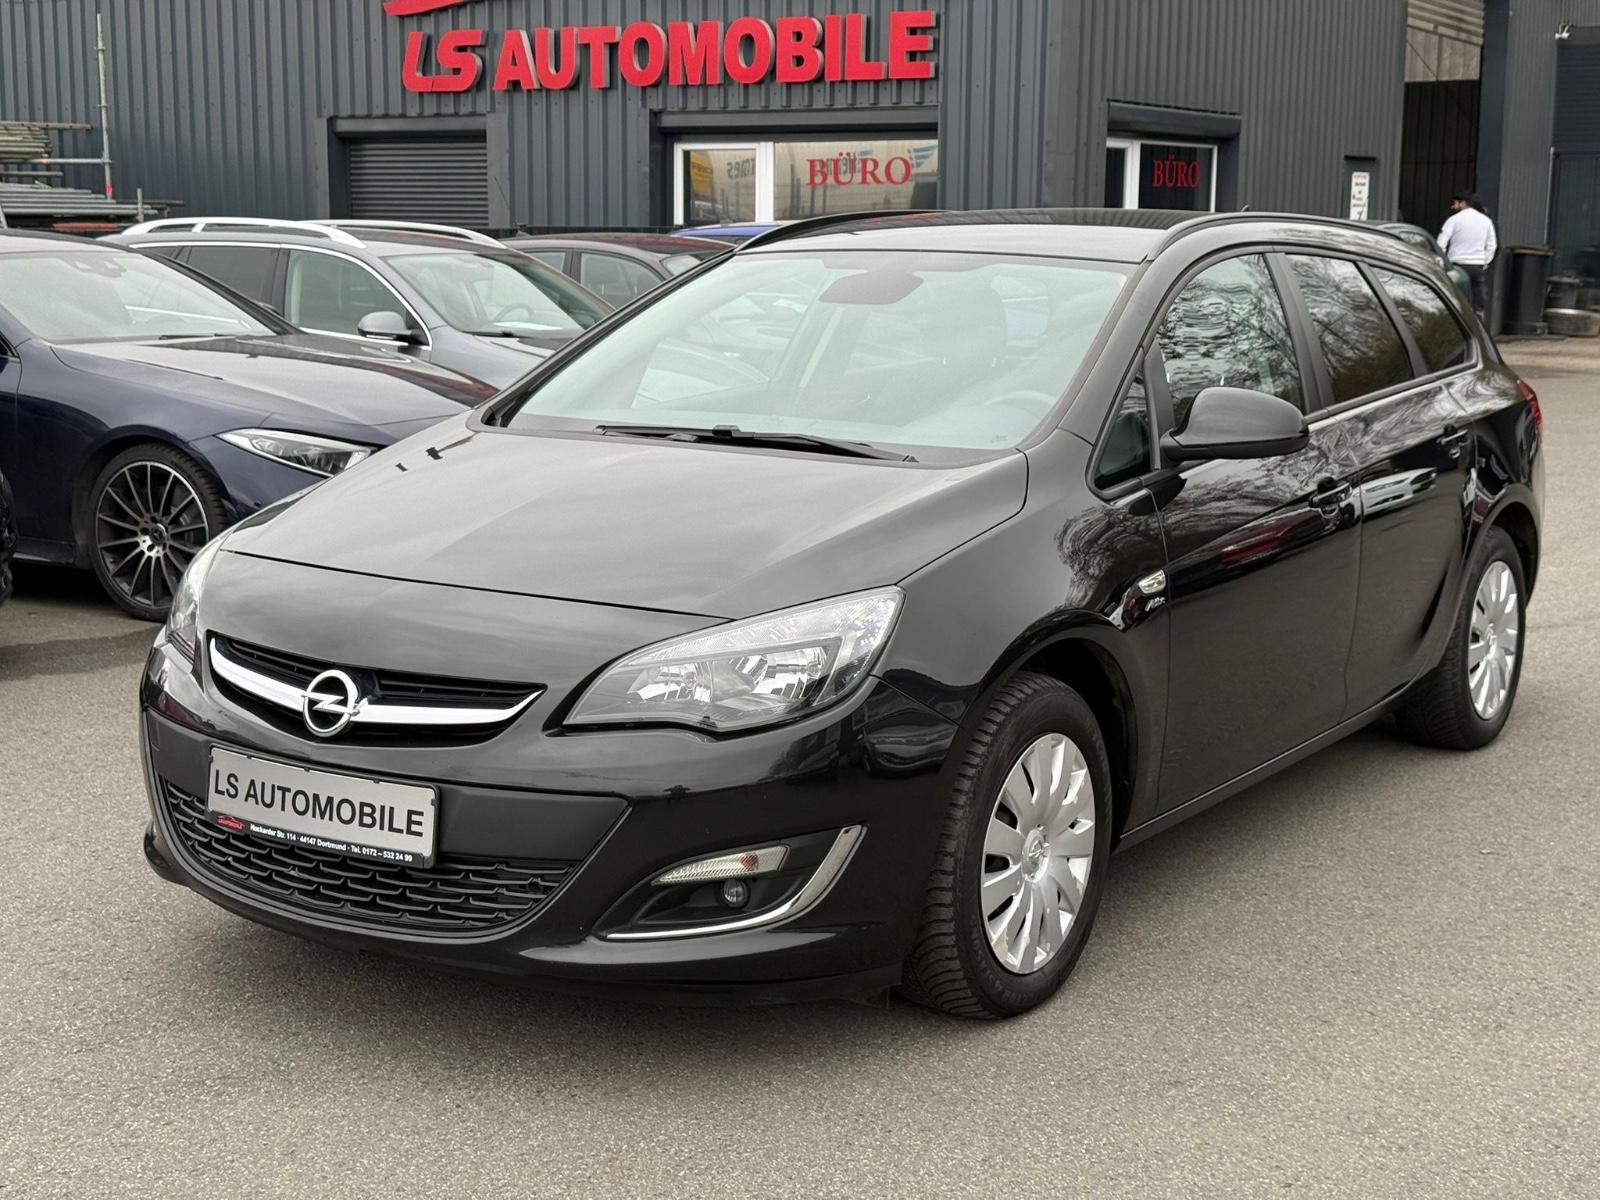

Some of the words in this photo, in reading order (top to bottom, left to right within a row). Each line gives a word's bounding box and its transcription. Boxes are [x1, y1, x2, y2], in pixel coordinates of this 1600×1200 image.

[401, 28, 485, 92] LS
[492, 10, 936, 91] AUTOMOBILE
[806, 152, 912, 187] BÜRO
[1152, 154, 1201, 189] BÜRO
[214, 769, 239, 799] LS
[244, 778, 425, 837] AUTOMOBILE
[277, 830, 285, 838] Str.
[300, 836, 316, 844] 44147
[317, 840, 346, 851] Dortmund
[351, 845, 361, 853] Tel.
[362, 847, 377, 856] 0172
[383, 851, 394, 859] 532
[405, 854, 412, 862] 99
